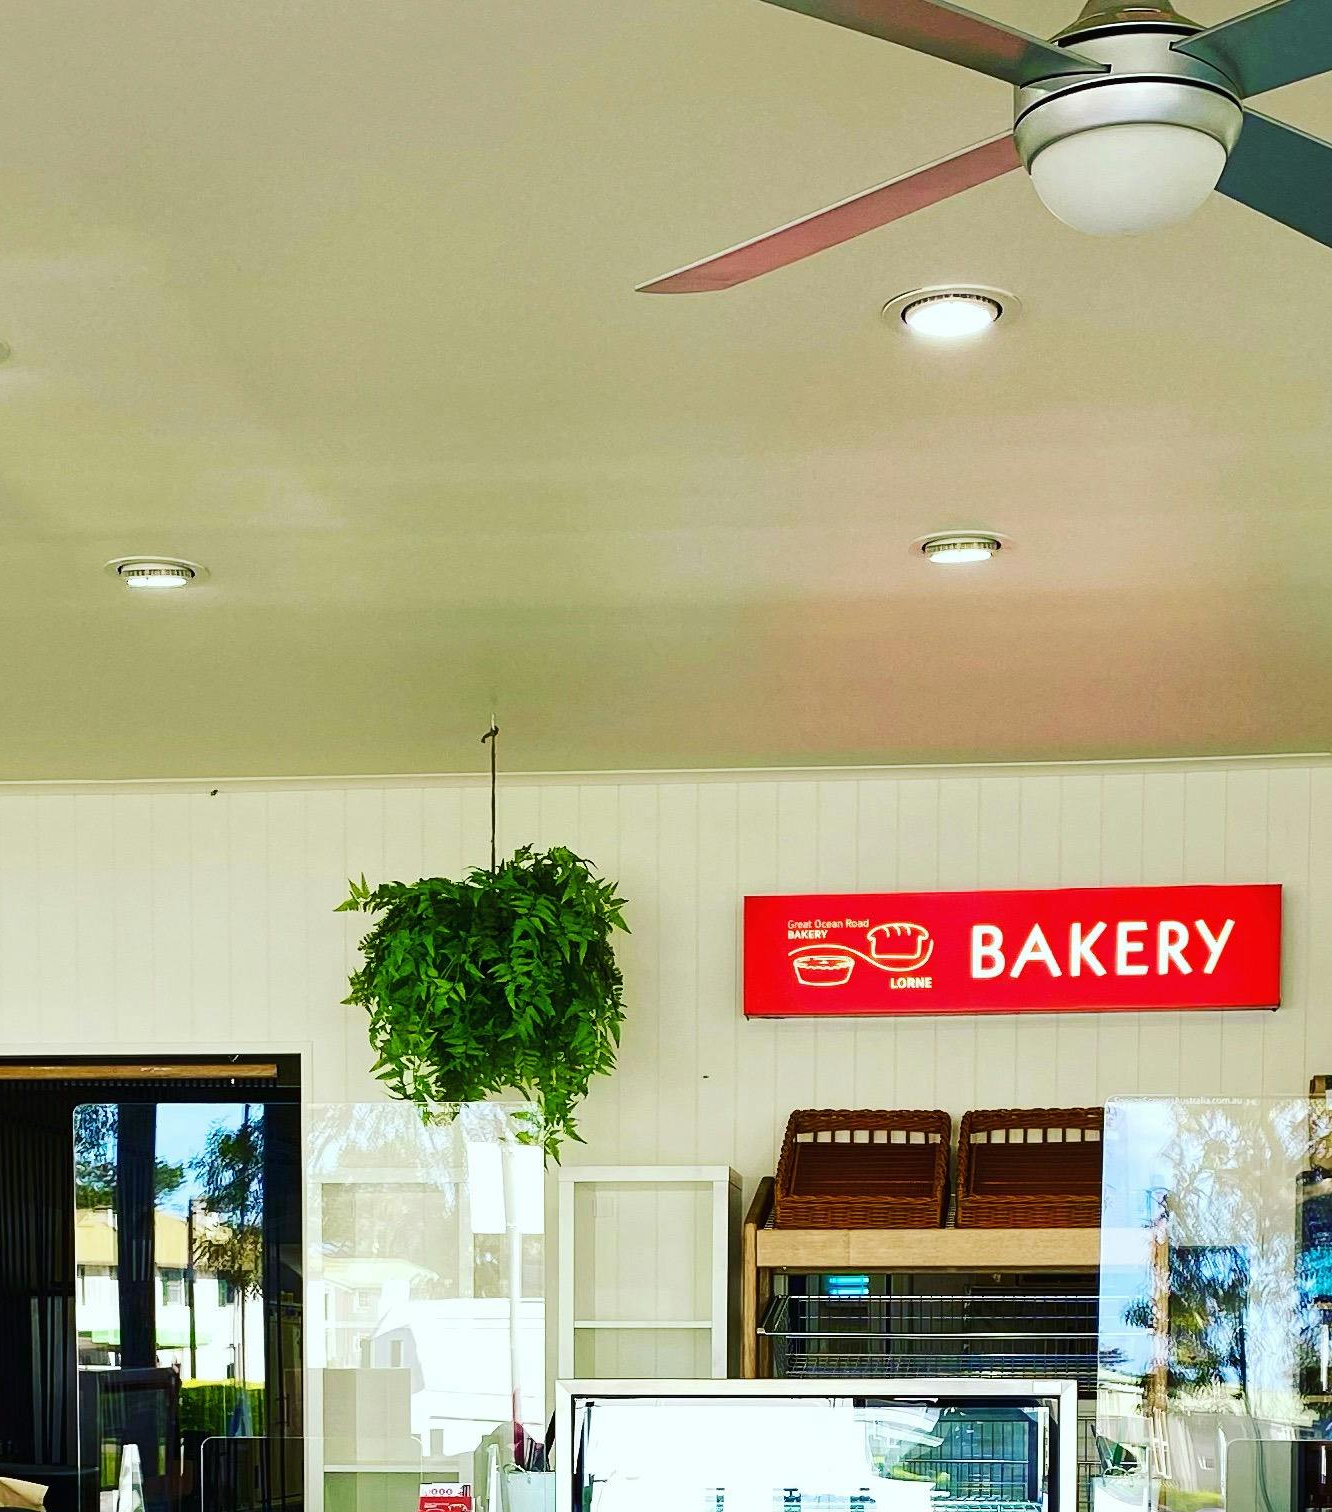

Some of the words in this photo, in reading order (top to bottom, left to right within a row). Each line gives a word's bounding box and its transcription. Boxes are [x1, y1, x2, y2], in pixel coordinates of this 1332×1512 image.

[787, 919, 812, 931] Great
[814, 918, 844, 930] Ocean
[846, 917, 870, 928] Road
[787, 930, 828, 940] BAKERY
[971, 918, 1235, 979] BAKERY
[890, 976, 933, 989] LORNE
